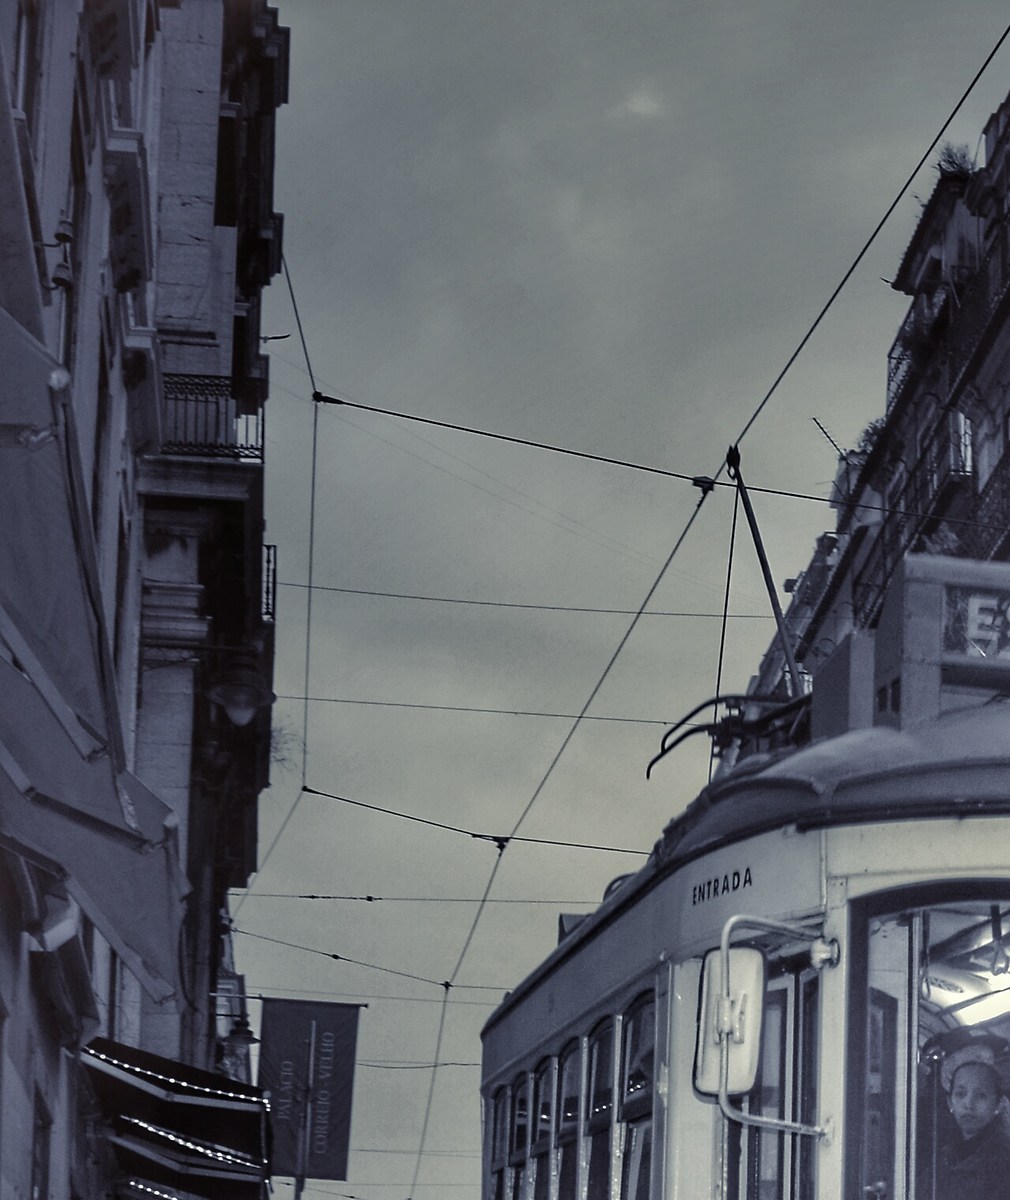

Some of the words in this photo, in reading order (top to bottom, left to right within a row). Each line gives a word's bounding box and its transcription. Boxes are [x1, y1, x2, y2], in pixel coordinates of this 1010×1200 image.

[692, 866, 752, 906] ENTRADA
[318, 1032, 335, 1079] VELHO
[313, 1090, 331, 1154] CORREIO
